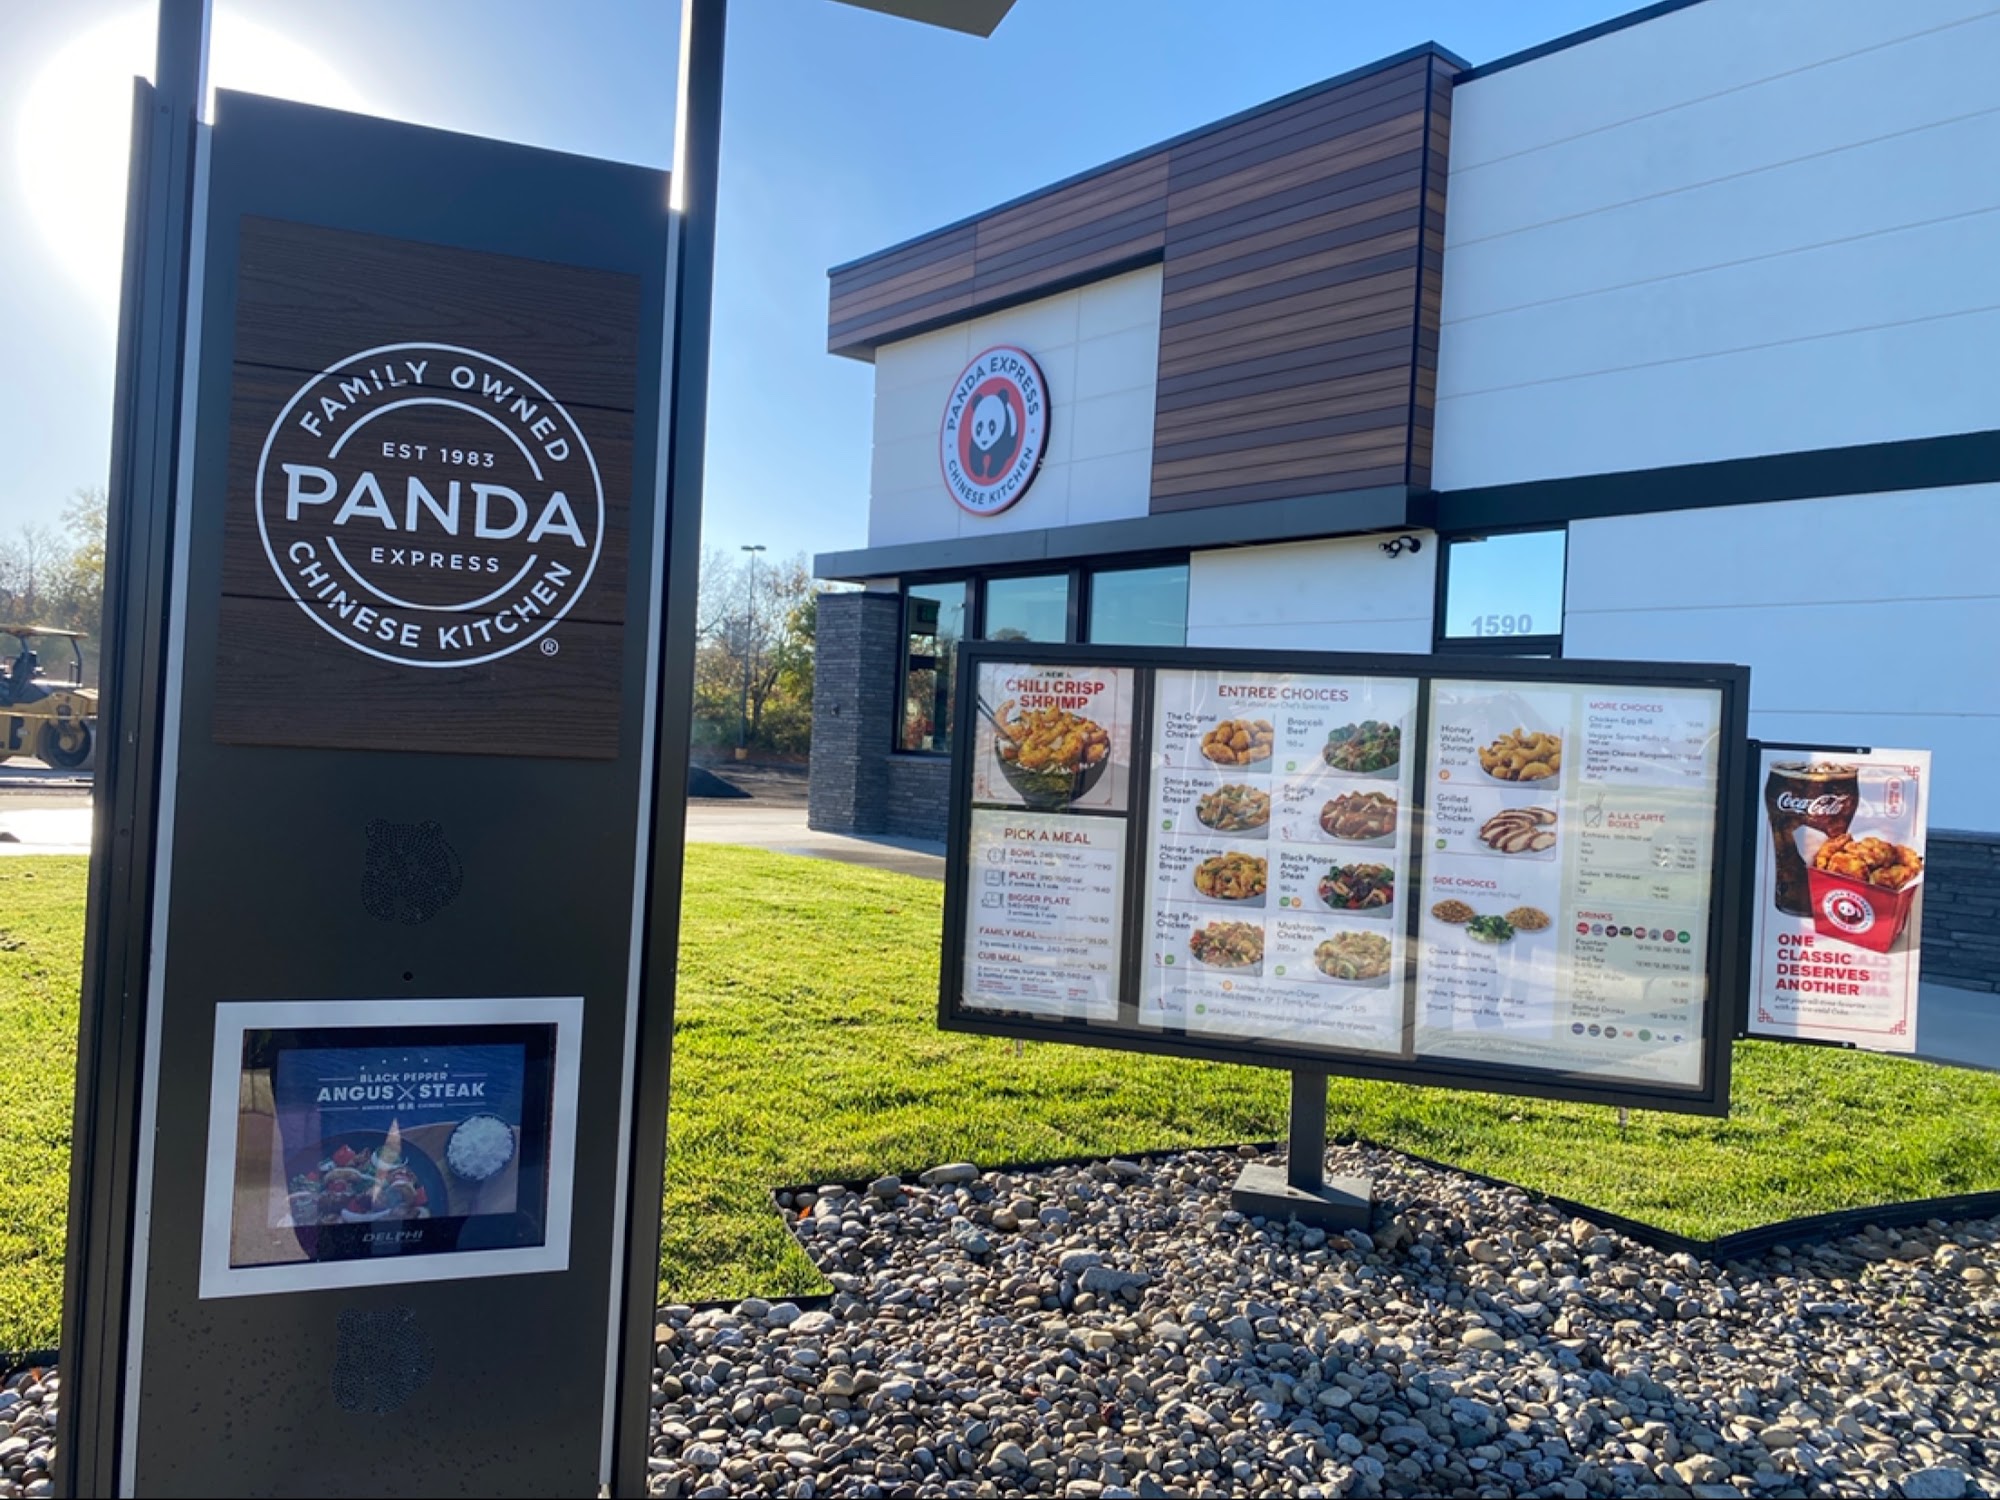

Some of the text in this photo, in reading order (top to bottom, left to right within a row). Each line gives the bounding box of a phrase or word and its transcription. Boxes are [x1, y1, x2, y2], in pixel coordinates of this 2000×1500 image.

[947, 357, 1039, 431] PANDA EXPRESS
[300, 361, 570, 462] FAMILY OWNED
[382, 442, 495, 467] EST 1983
[949, 447, 1034, 505] CHINESE KITCHEN
[282, 463, 586, 548] PANDA
[370, 547, 500, 572] EXPRESS
[289, 541, 572, 650] CHINESE KITCHEN
[1471, 613, 1533, 637] 1590
[1005, 679, 1105, 695] CHILI CRISP
[1219, 685, 1348, 702] ENTREE CHOICES
[1020, 695, 1089, 710] SHRIMP
[1590, 702, 1663, 713] MORE CHOICES
[1441, 725, 1472, 735] Honey
[1441, 734, 1474, 744] Walnut
[1440, 744, 1475, 754] Shrimp
[1437, 794, 1469, 803] Grilled
[1437, 803, 1472, 814] Teriyaki
[1436, 813, 1474, 823] Chicken
[1608, 819, 1640, 829] BOXES
[1633, 813, 1665, 823] CARTE
[1004, 828, 1091, 845] PICK A MEAL
[1010, 848, 1037, 858] BOWL
[1009, 871, 1037, 880] PLATE
[1433, 876, 1497, 889] SIDE CHOICES
[1008, 893, 1041, 903] BIGGER
[1043, 895, 1071, 906] PLATE
[1577, 911, 1613, 921] DRINKS
[979, 926, 1037, 939] FAMILY MEAL
[1778, 933, 1814, 947] ONE
[978, 951, 1023, 963] CUB MEAL
[1777, 948, 1852, 965] CLASSIC
[1776, 963, 1870, 982] DESERVES
[1776, 978, 1860, 996] ANOTHER
[360, 1071, 449, 1083] BLACK PEPPER
[317, 1082, 486, 1102] ANGUS STEAK
[362, 1229, 424, 1243] DELPHI
